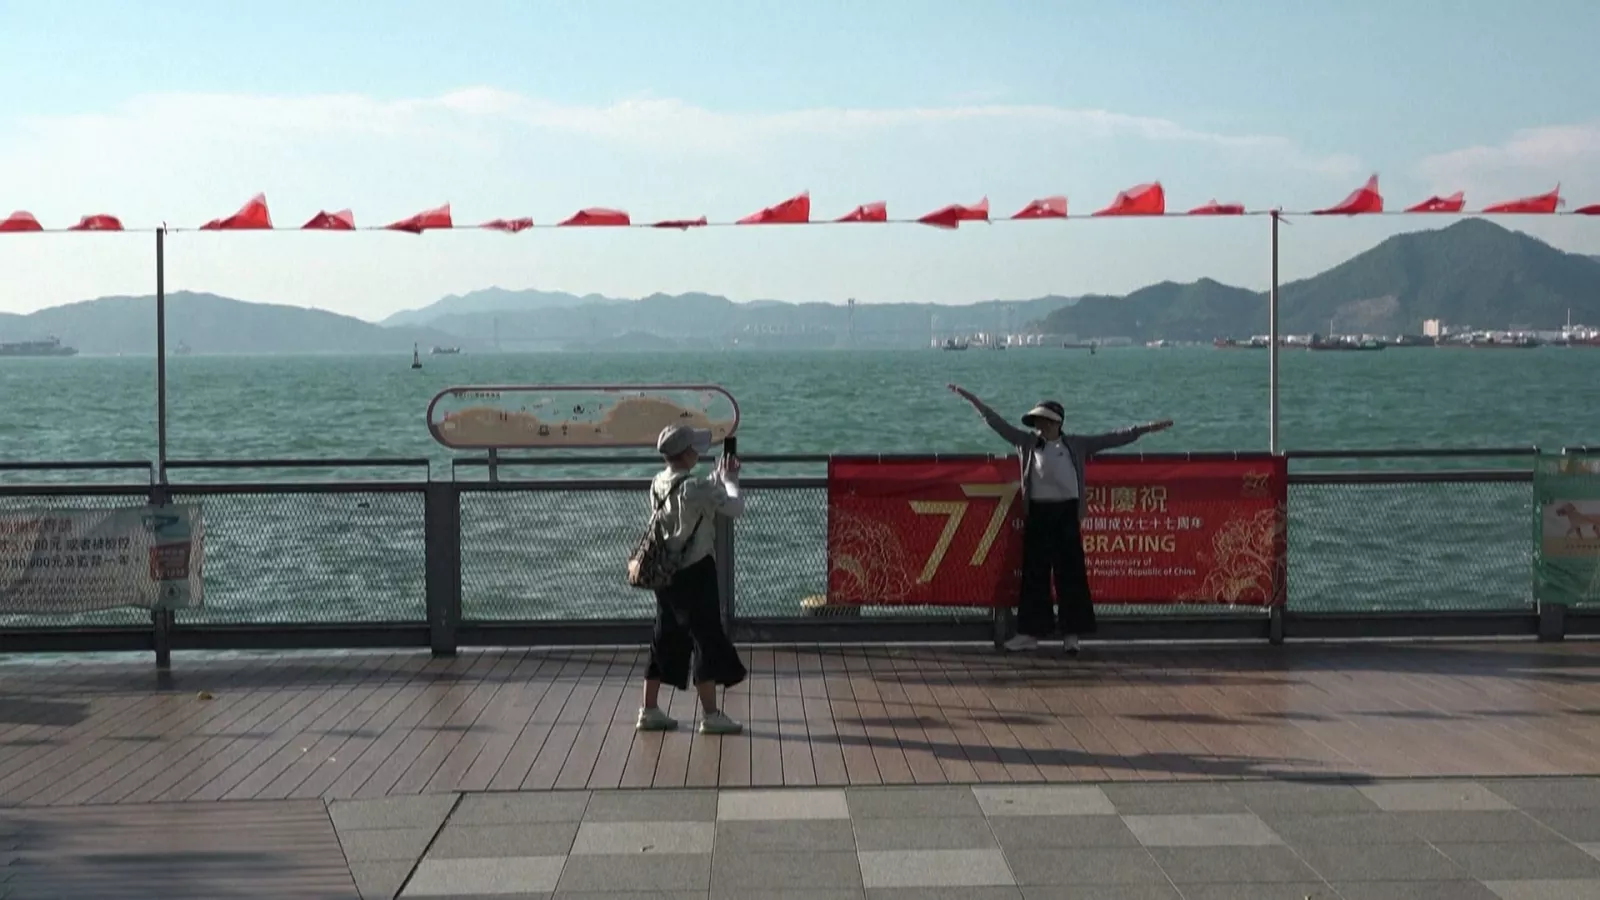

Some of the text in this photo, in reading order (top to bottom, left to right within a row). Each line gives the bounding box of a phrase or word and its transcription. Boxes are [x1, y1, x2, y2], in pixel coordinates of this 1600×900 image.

[1085, 486, 1168, 512] 烈慶祝
[908, 480, 1022, 584] 77
[1082, 534, 1176, 552] BRATING
[1095, 558, 1142, 569] Anniversary
[1144, 558, 1153, 567] of
[1093, 568, 1127, 579] People's
[1128, 568, 1162, 579] Republic
[1163, 568, 1173, 577] of
[1174, 567, 1197, 577] China
